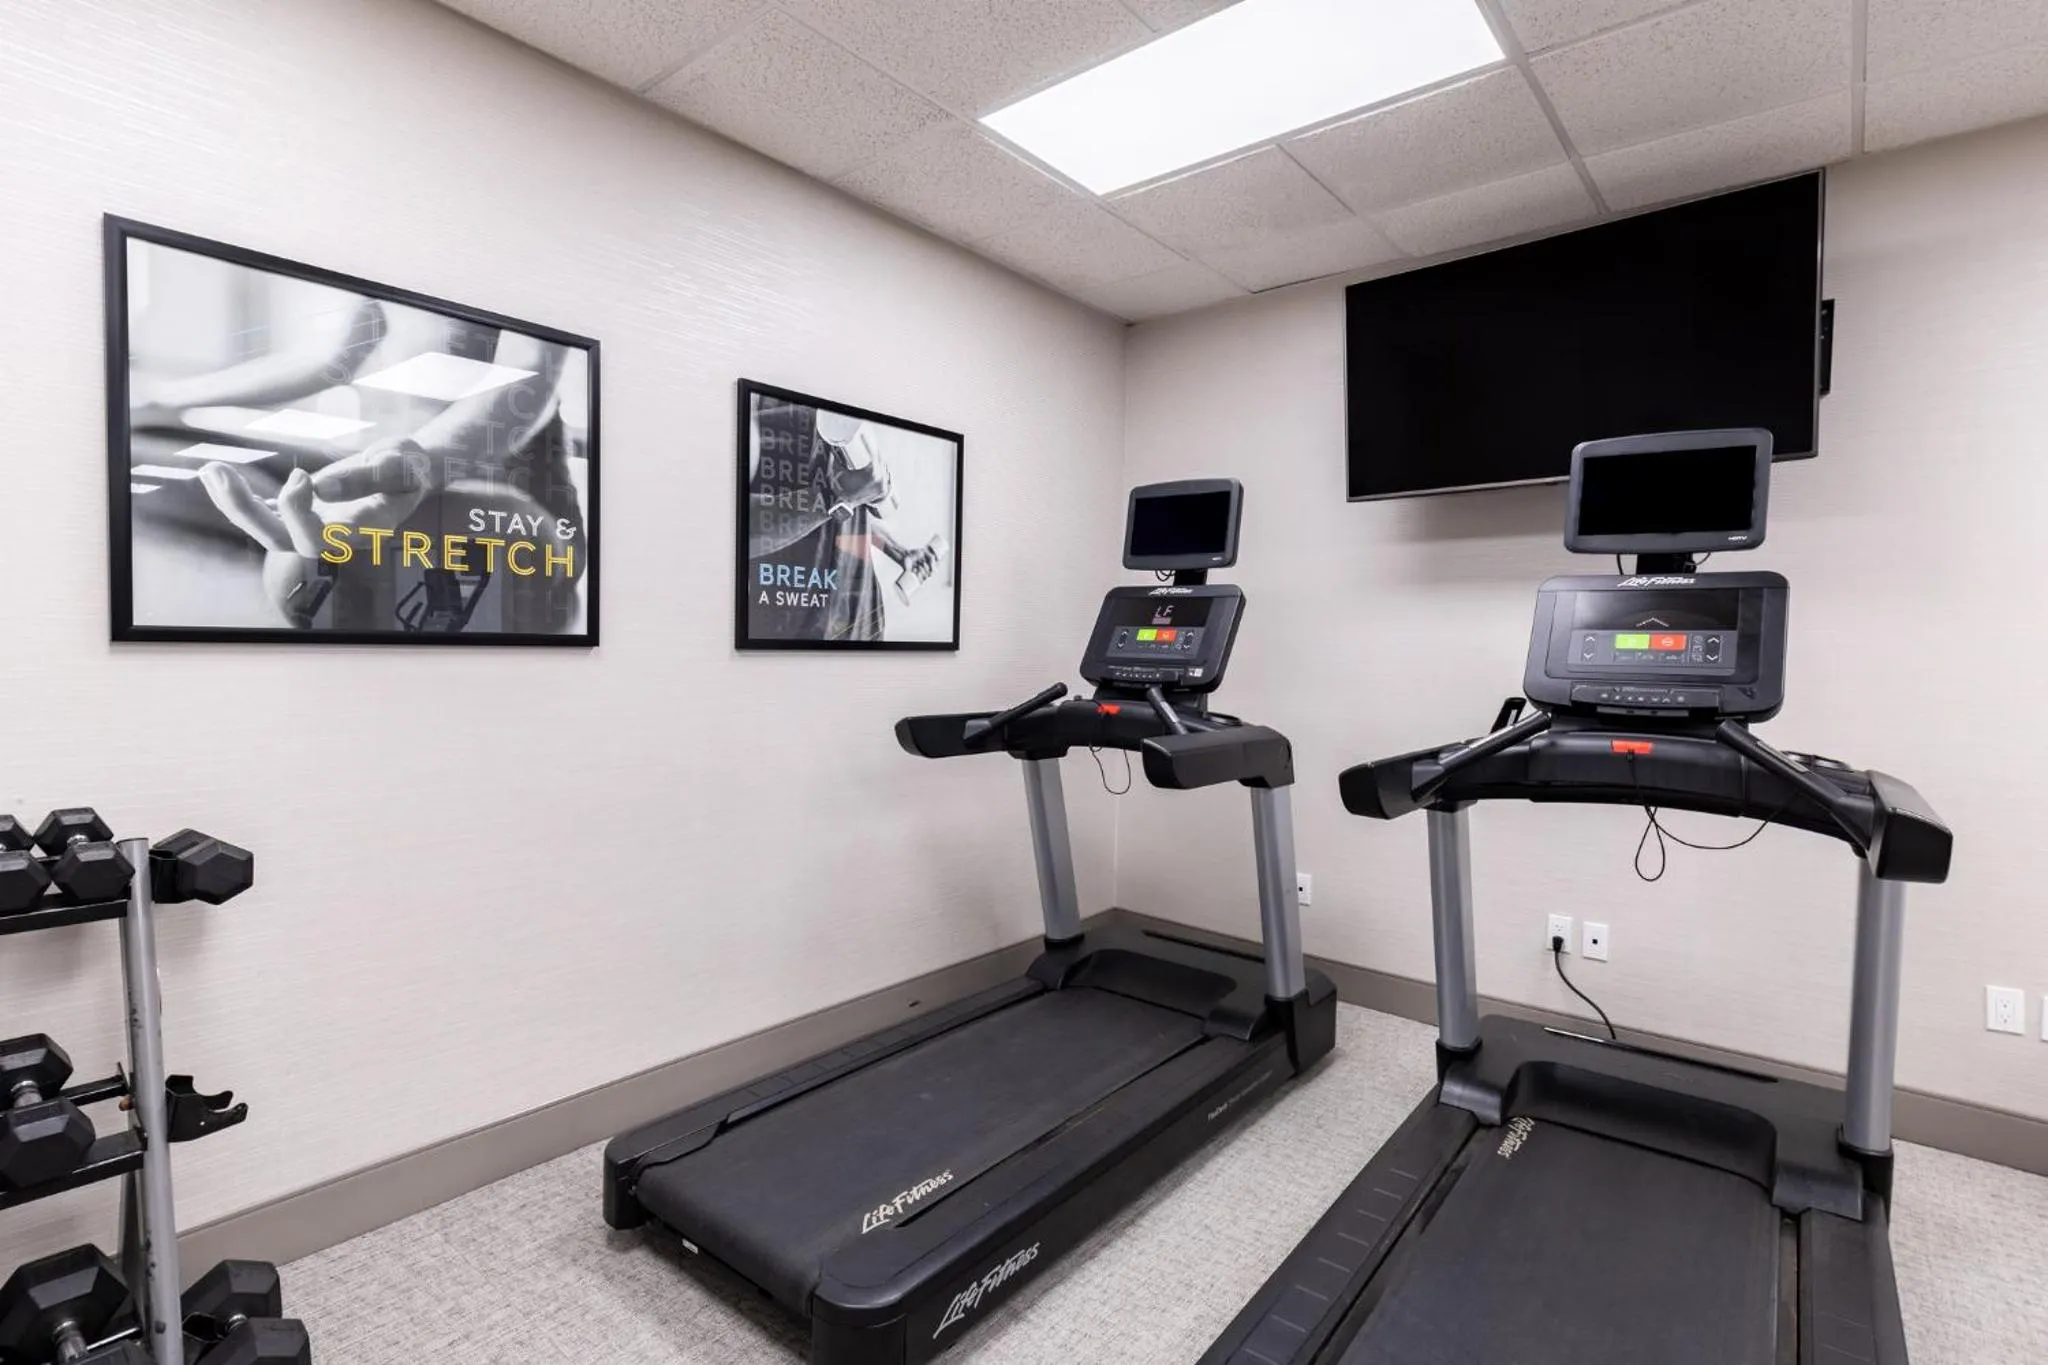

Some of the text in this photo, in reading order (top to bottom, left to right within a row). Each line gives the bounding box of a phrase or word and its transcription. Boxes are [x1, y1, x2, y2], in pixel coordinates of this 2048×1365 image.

[468, 508, 577, 540] STAY &
[320, 522, 575, 578] STRETCH
[759, 563, 838, 591] BREAK
[758, 590, 829, 608] A SWEAT
